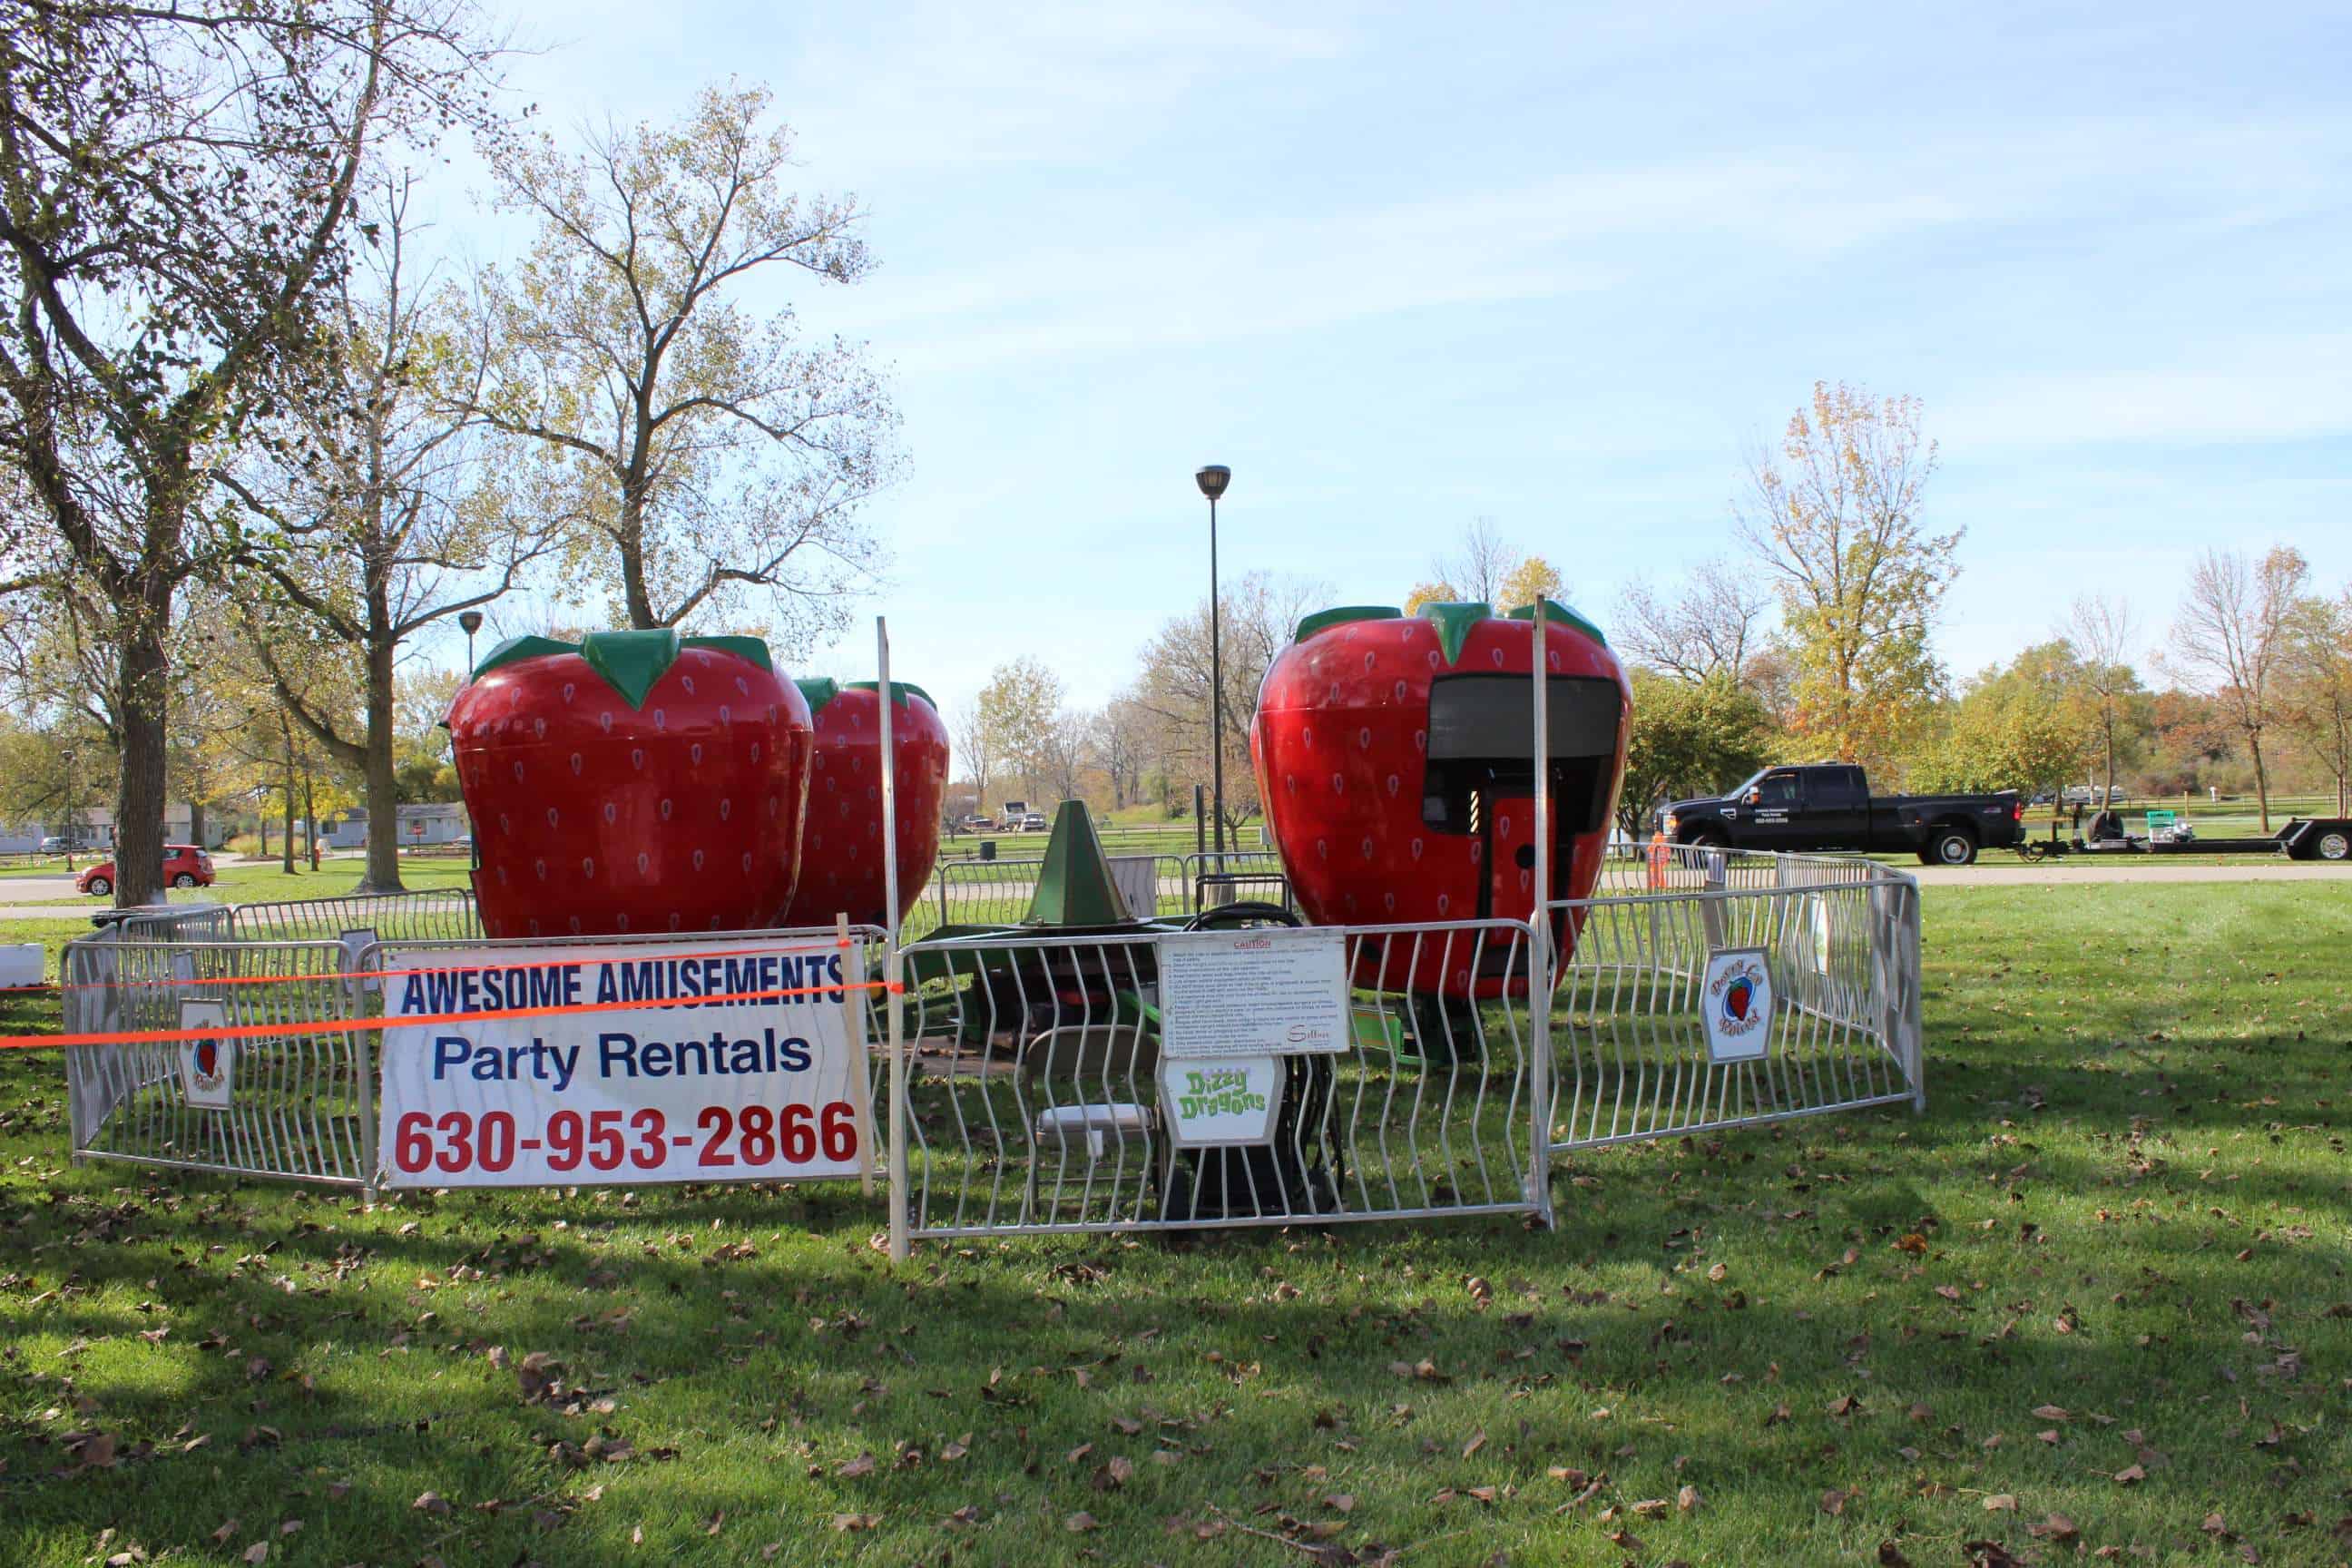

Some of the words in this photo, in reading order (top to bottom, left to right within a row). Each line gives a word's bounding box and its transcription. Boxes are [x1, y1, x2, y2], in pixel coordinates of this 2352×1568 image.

[1234, 938, 1271, 949] CAUTION
[400, 964, 582, 1014] AWESOME
[595, 953, 845, 1010] AMUSEMENTS
[433, 1035, 581, 1092] Party
[598, 1027, 812, 1079] Rentals
[1186, 1071, 1247, 1097] Dizzy
[1179, 1093, 1266, 1119] Dragons
[395, 1101, 858, 1174] 630-953-2866
